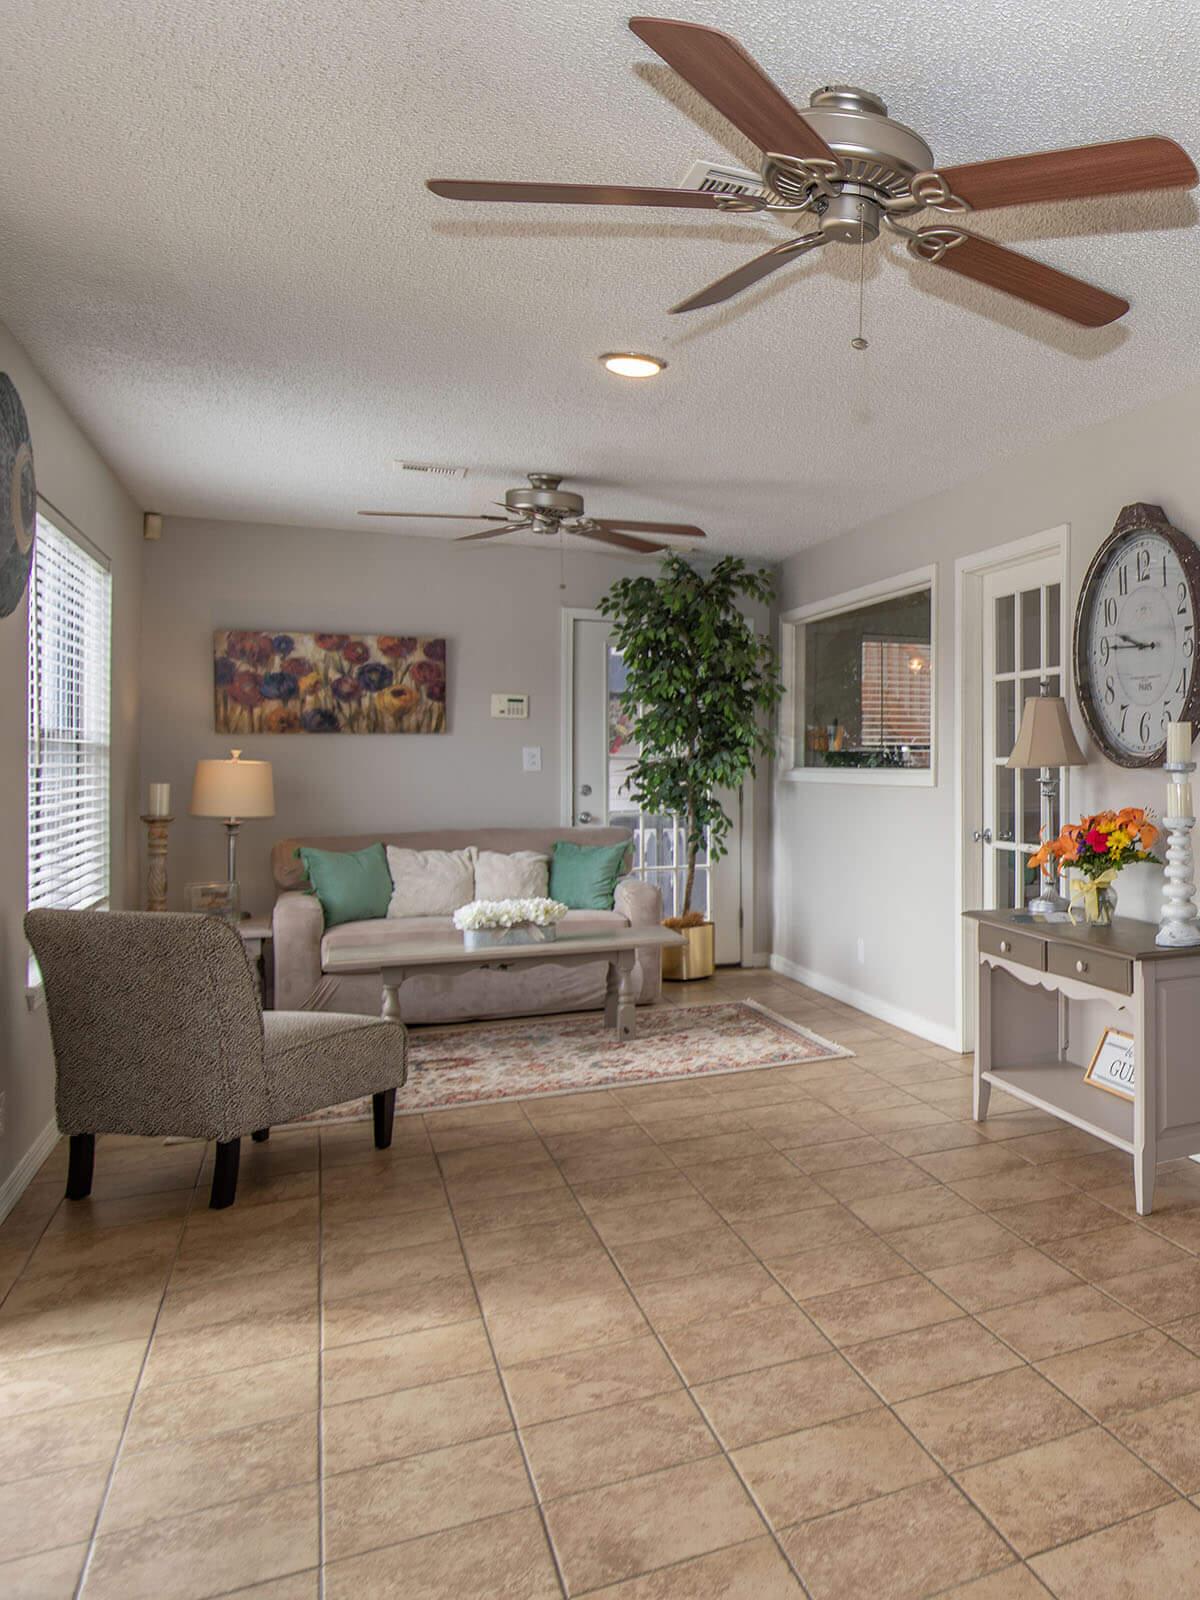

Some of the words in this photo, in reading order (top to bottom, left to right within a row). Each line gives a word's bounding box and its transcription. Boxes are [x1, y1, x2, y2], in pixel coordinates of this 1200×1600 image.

[1119, 565, 1128, 596] 11
[1136, 550, 1150, 582] 12
[1162, 556, 1167, 587] 1
[1104, 598, 1117, 628] 10
[1177, 582, 1187, 615] 2
[1100, 636, 1110, 667] 9
[1183, 625, 1194, 658] 3
[1104, 675, 1115, 705] 8
[1175, 667, 1187, 699] 4
[1120, 704, 1130, 733] 7
[1139, 711, 1150, 744] 6
[1160, 701, 1172, 729] 5
